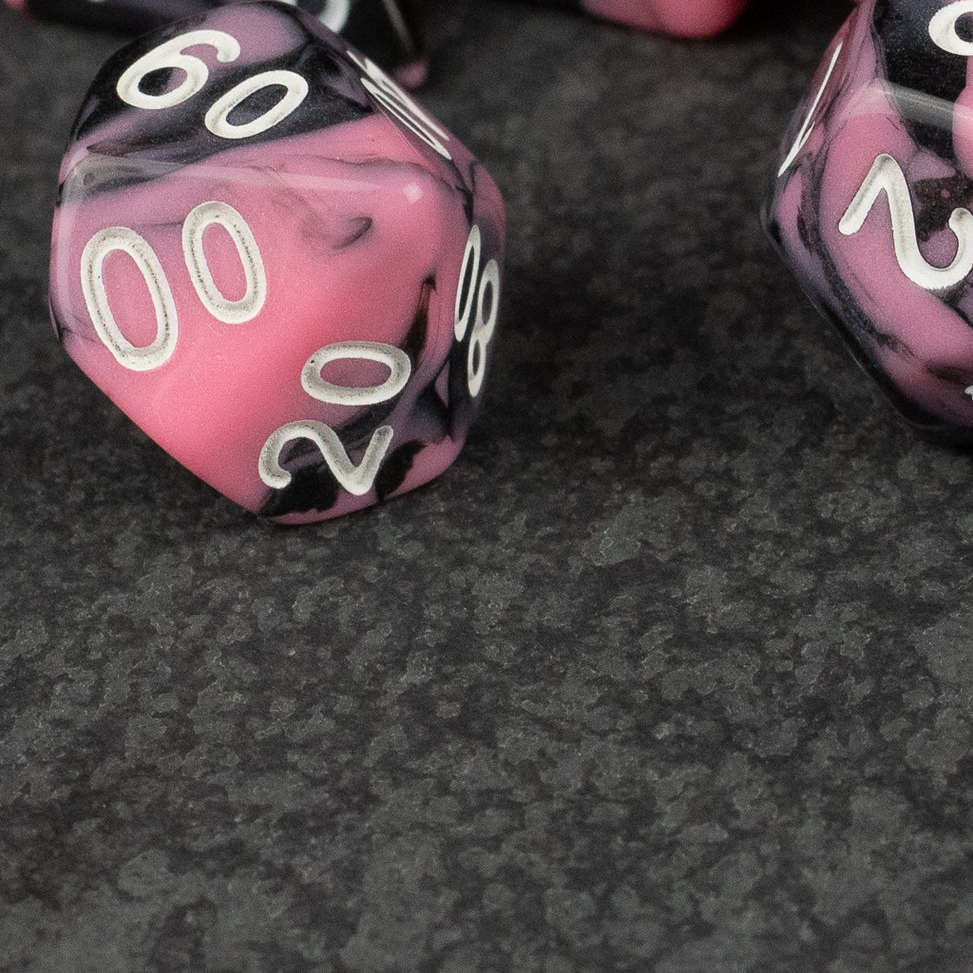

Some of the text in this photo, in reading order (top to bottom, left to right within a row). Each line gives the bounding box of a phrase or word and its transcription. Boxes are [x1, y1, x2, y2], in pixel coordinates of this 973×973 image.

[116, 29, 309, 139] 60
[80, 200, 268, 372] 00
[257, 340, 412, 497] 20
